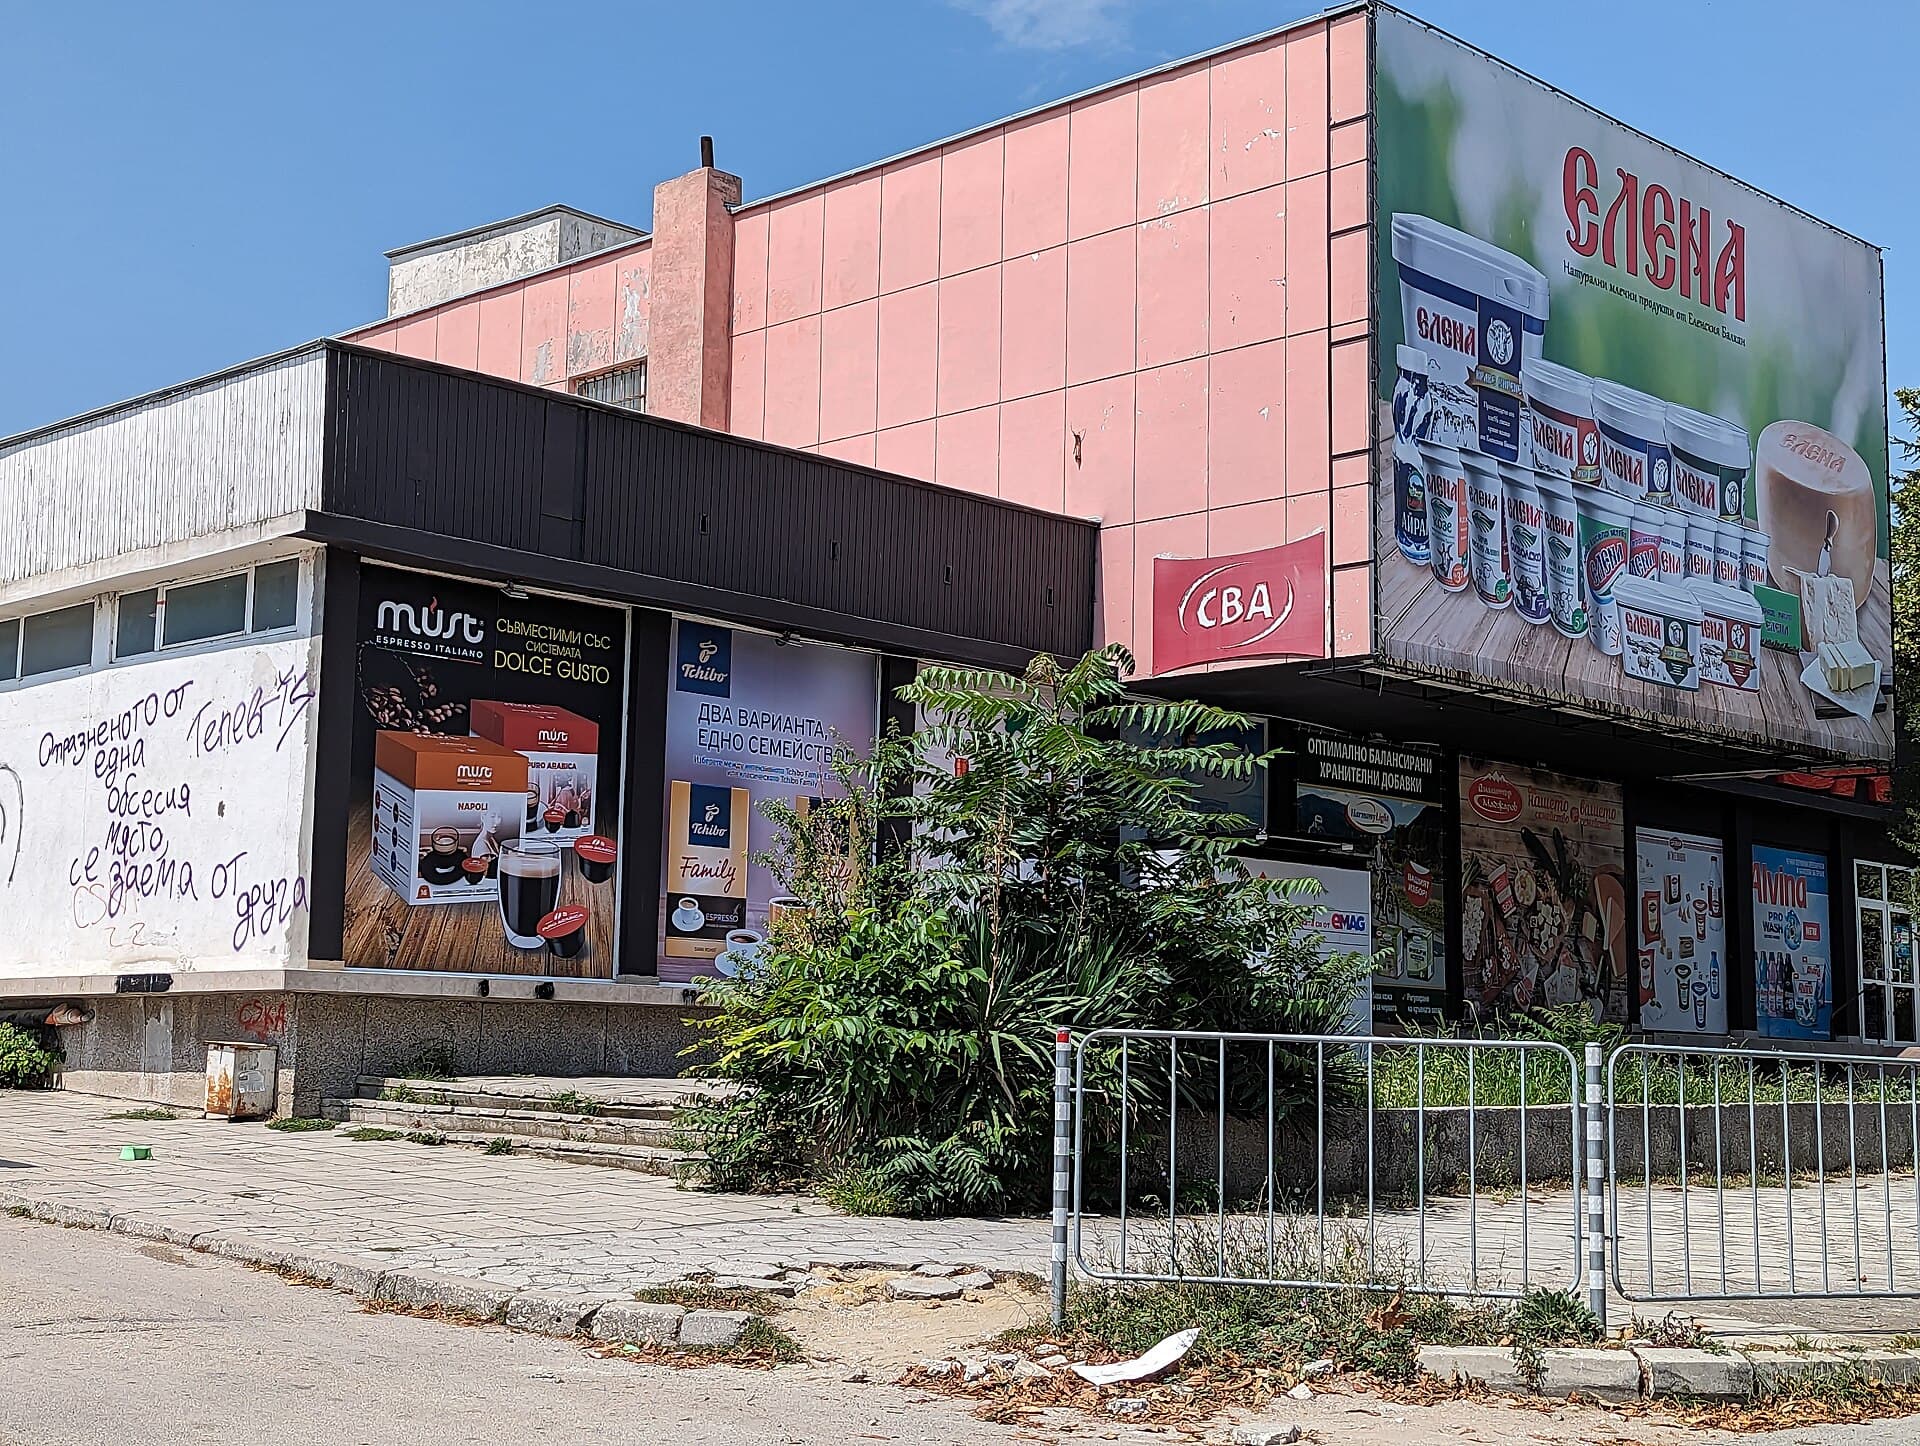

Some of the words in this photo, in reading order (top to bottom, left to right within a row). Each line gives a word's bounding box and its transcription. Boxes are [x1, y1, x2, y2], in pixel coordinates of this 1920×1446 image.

[1563, 260, 1608, 291] Натурални
[1638, 295, 1675, 317] продукти
[1676, 311, 1687, 323] от
[1196, 581, 1274, 629] CBA
[376, 635, 431, 651] ESPRESSO
[435, 644, 484, 659] ITALIANO
[496, 618, 582, 645] СЪВМЕСТИМИ
[584, 633, 611, 650] СЪС
[526, 640, 582, 660] СИСТЕМАТА
[494, 650, 552, 676] DOLCE
[557, 660, 610, 684] GUSTO
[681, 663, 728, 683] Tchibo
[698, 703, 733, 726] ДВА
[738, 708, 829, 741] ВАРИАНТА,
[698, 728, 744, 752] ЕДНО
[1307, 737, 1368, 762] ОПТИМАЛНО
[1369, 748, 1433, 774] БАЛАНСИРАНИ
[94, 738, 146, 789] една
[1319, 761, 1380, 786] ХРАНИТЕЛНИ
[1381, 772, 1422, 793] ДОБАВКИ
[457, 802, 488, 811] NAPOLI
[691, 822, 728, 837] Tchibo
[70, 847, 99, 886] се
[108, 858, 198, 918] заема
[680, 855, 737, 893] Family
[1752, 862, 1807, 909] Alvina
[233, 876, 309, 952] друга
[705, 912, 739, 922] ESPRESSO
[1331, 912, 1366, 932] eMAG
